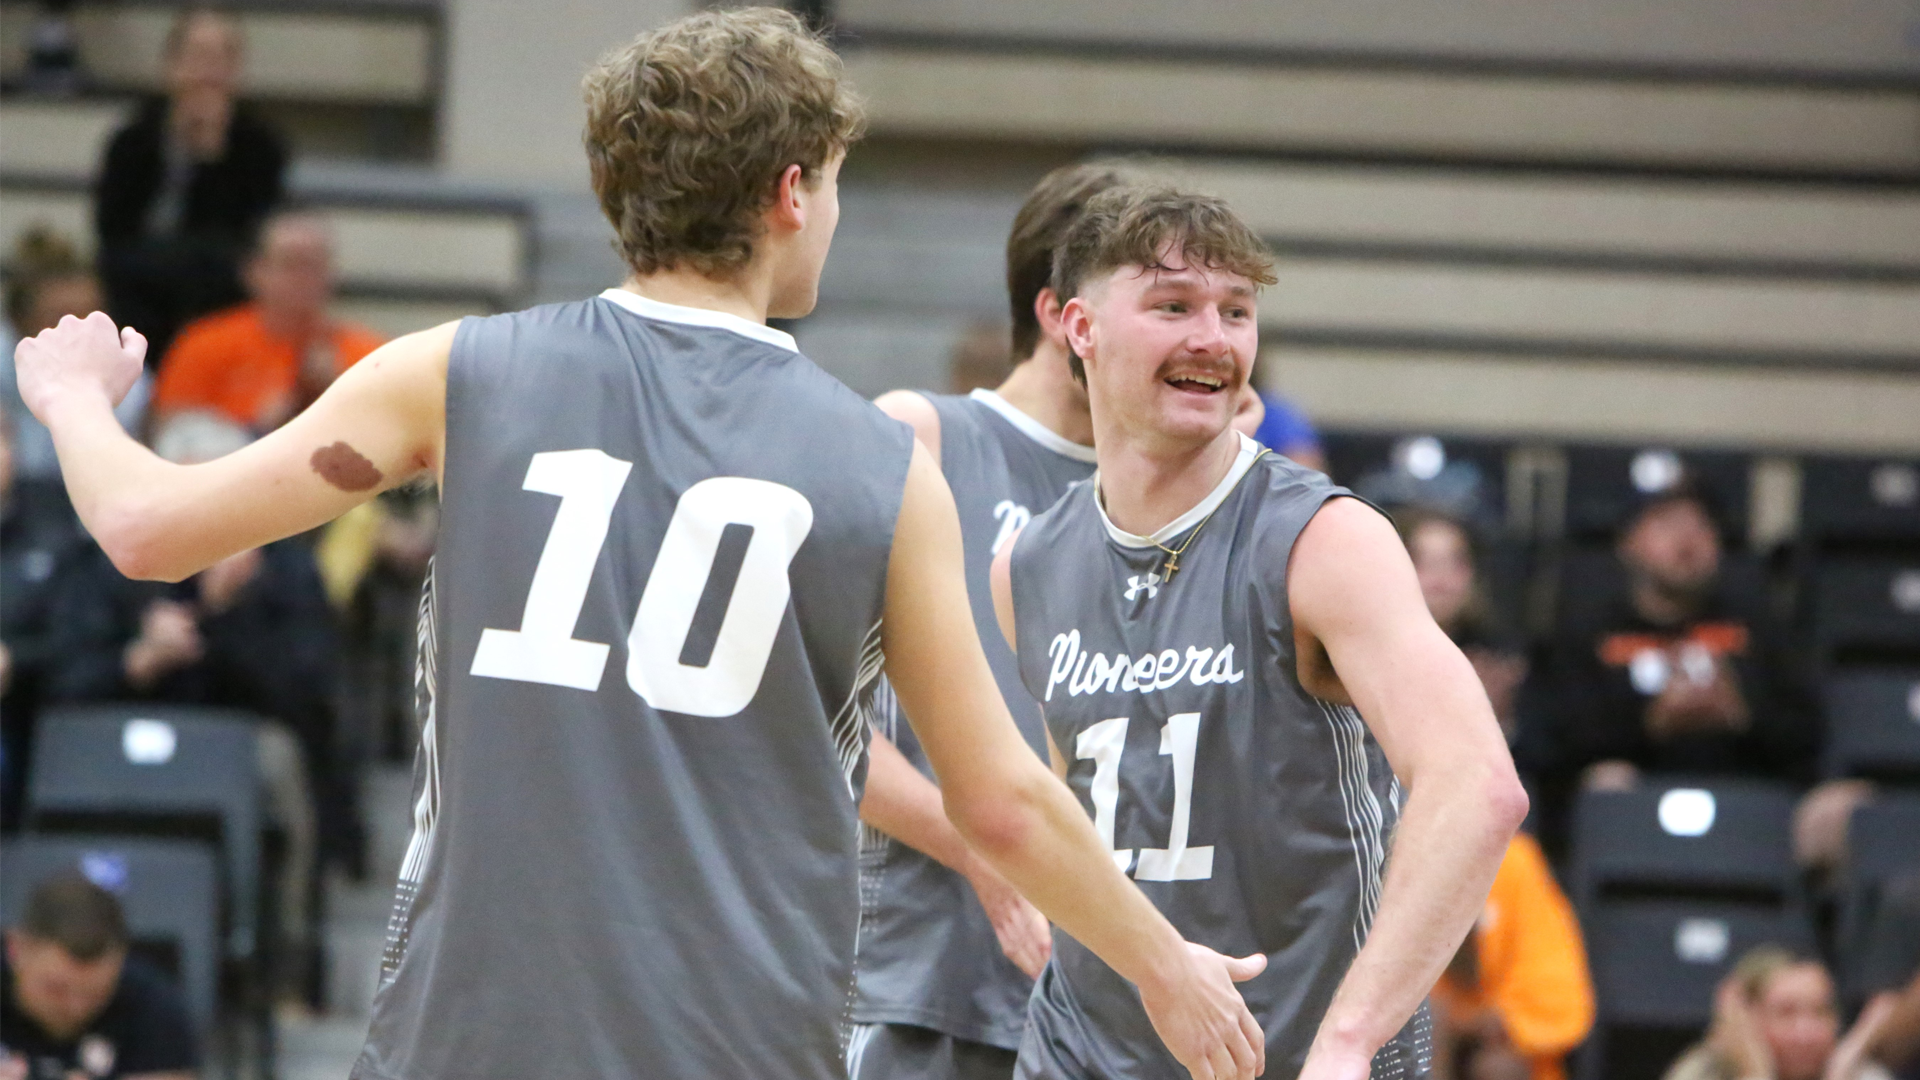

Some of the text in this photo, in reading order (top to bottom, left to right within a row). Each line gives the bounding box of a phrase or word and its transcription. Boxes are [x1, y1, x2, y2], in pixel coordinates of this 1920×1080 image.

[470, 449, 814, 718] 10
[1045, 628, 1244, 702] Pioneers
[1076, 712, 1215, 881] 11
